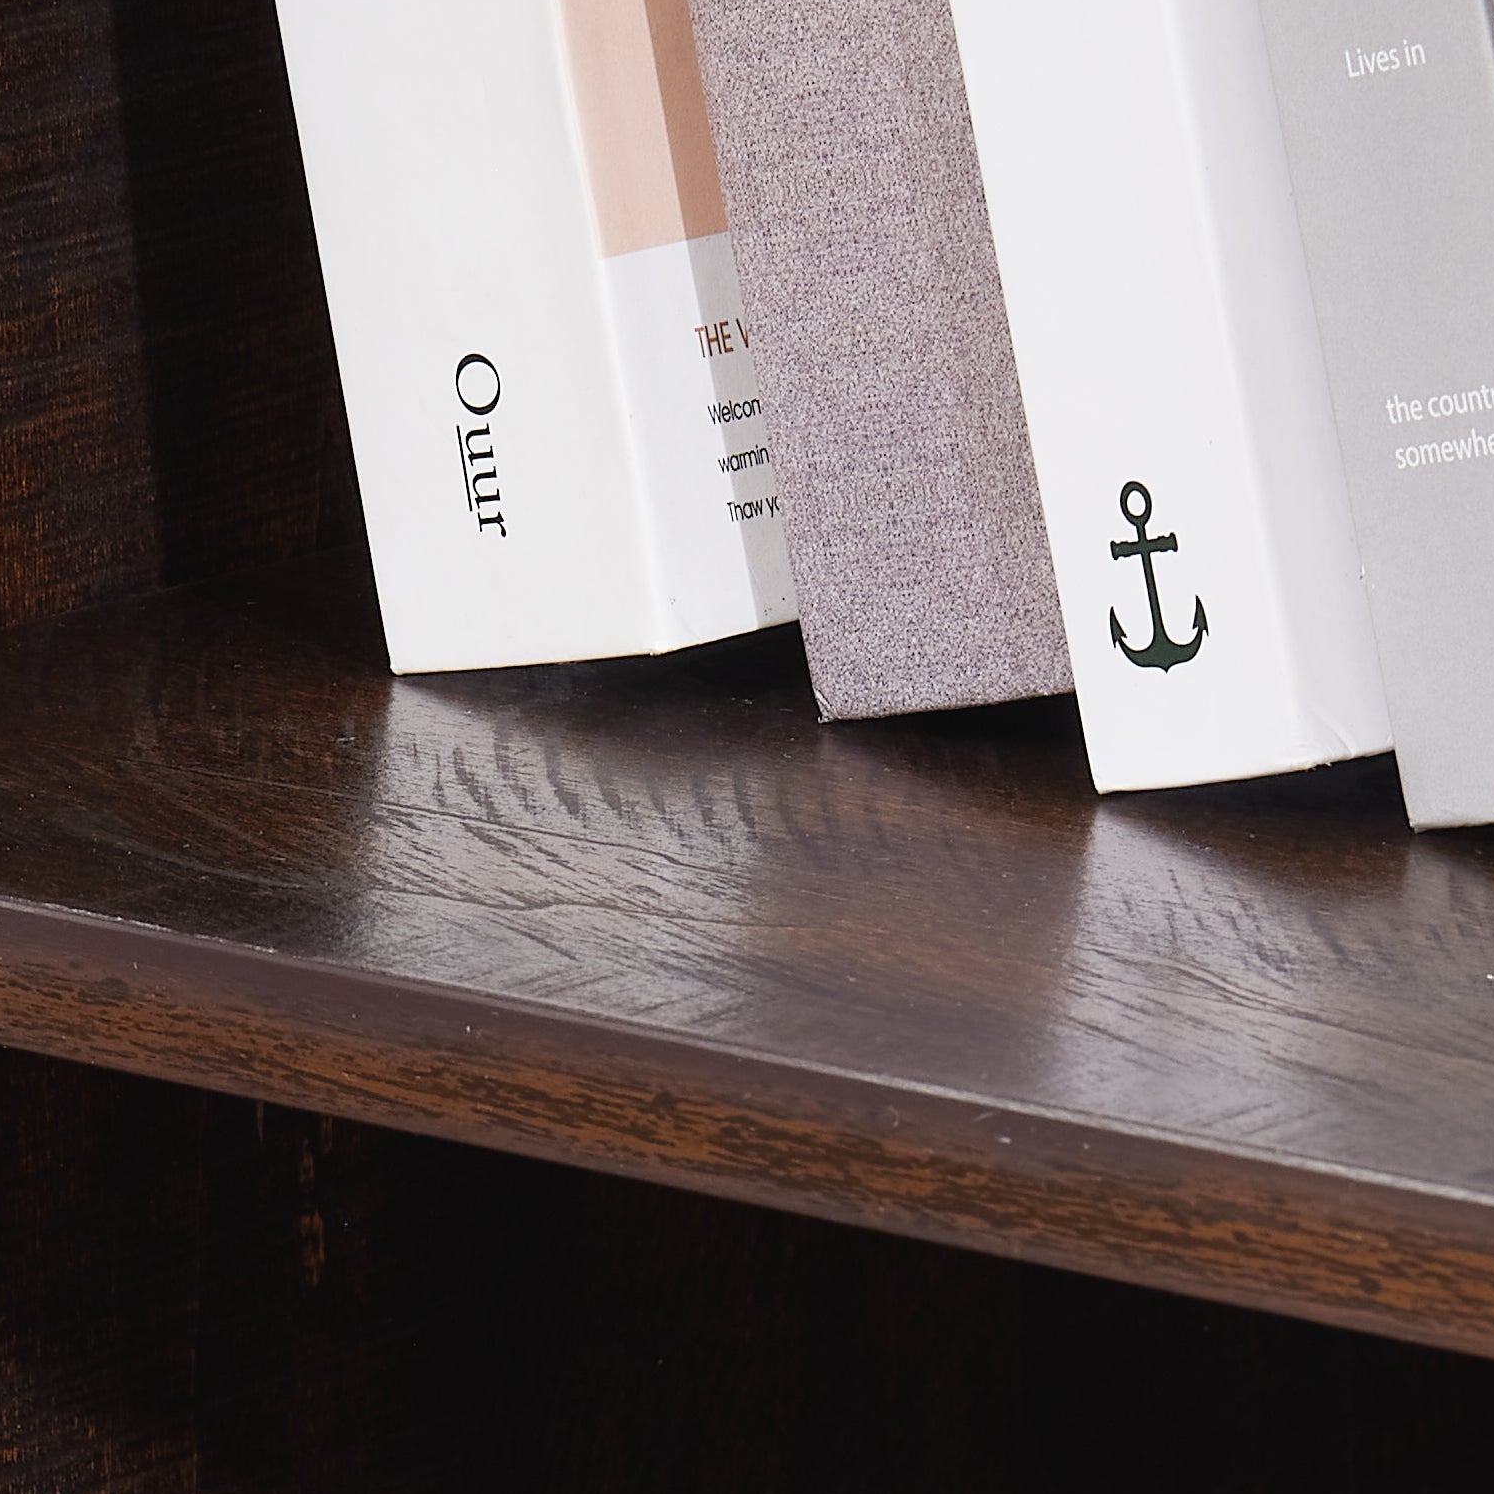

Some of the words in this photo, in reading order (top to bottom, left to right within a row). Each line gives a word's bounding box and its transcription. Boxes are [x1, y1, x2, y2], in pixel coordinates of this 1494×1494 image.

[1344, 44, 1402, 78] Lives
[1402, 38, 1427, 67] in
[694, 320, 735, 358] THE
[1385, 393, 1424, 425] the
[455, 352, 507, 539] Ouur
[726, 499, 763, 523] Thaw
